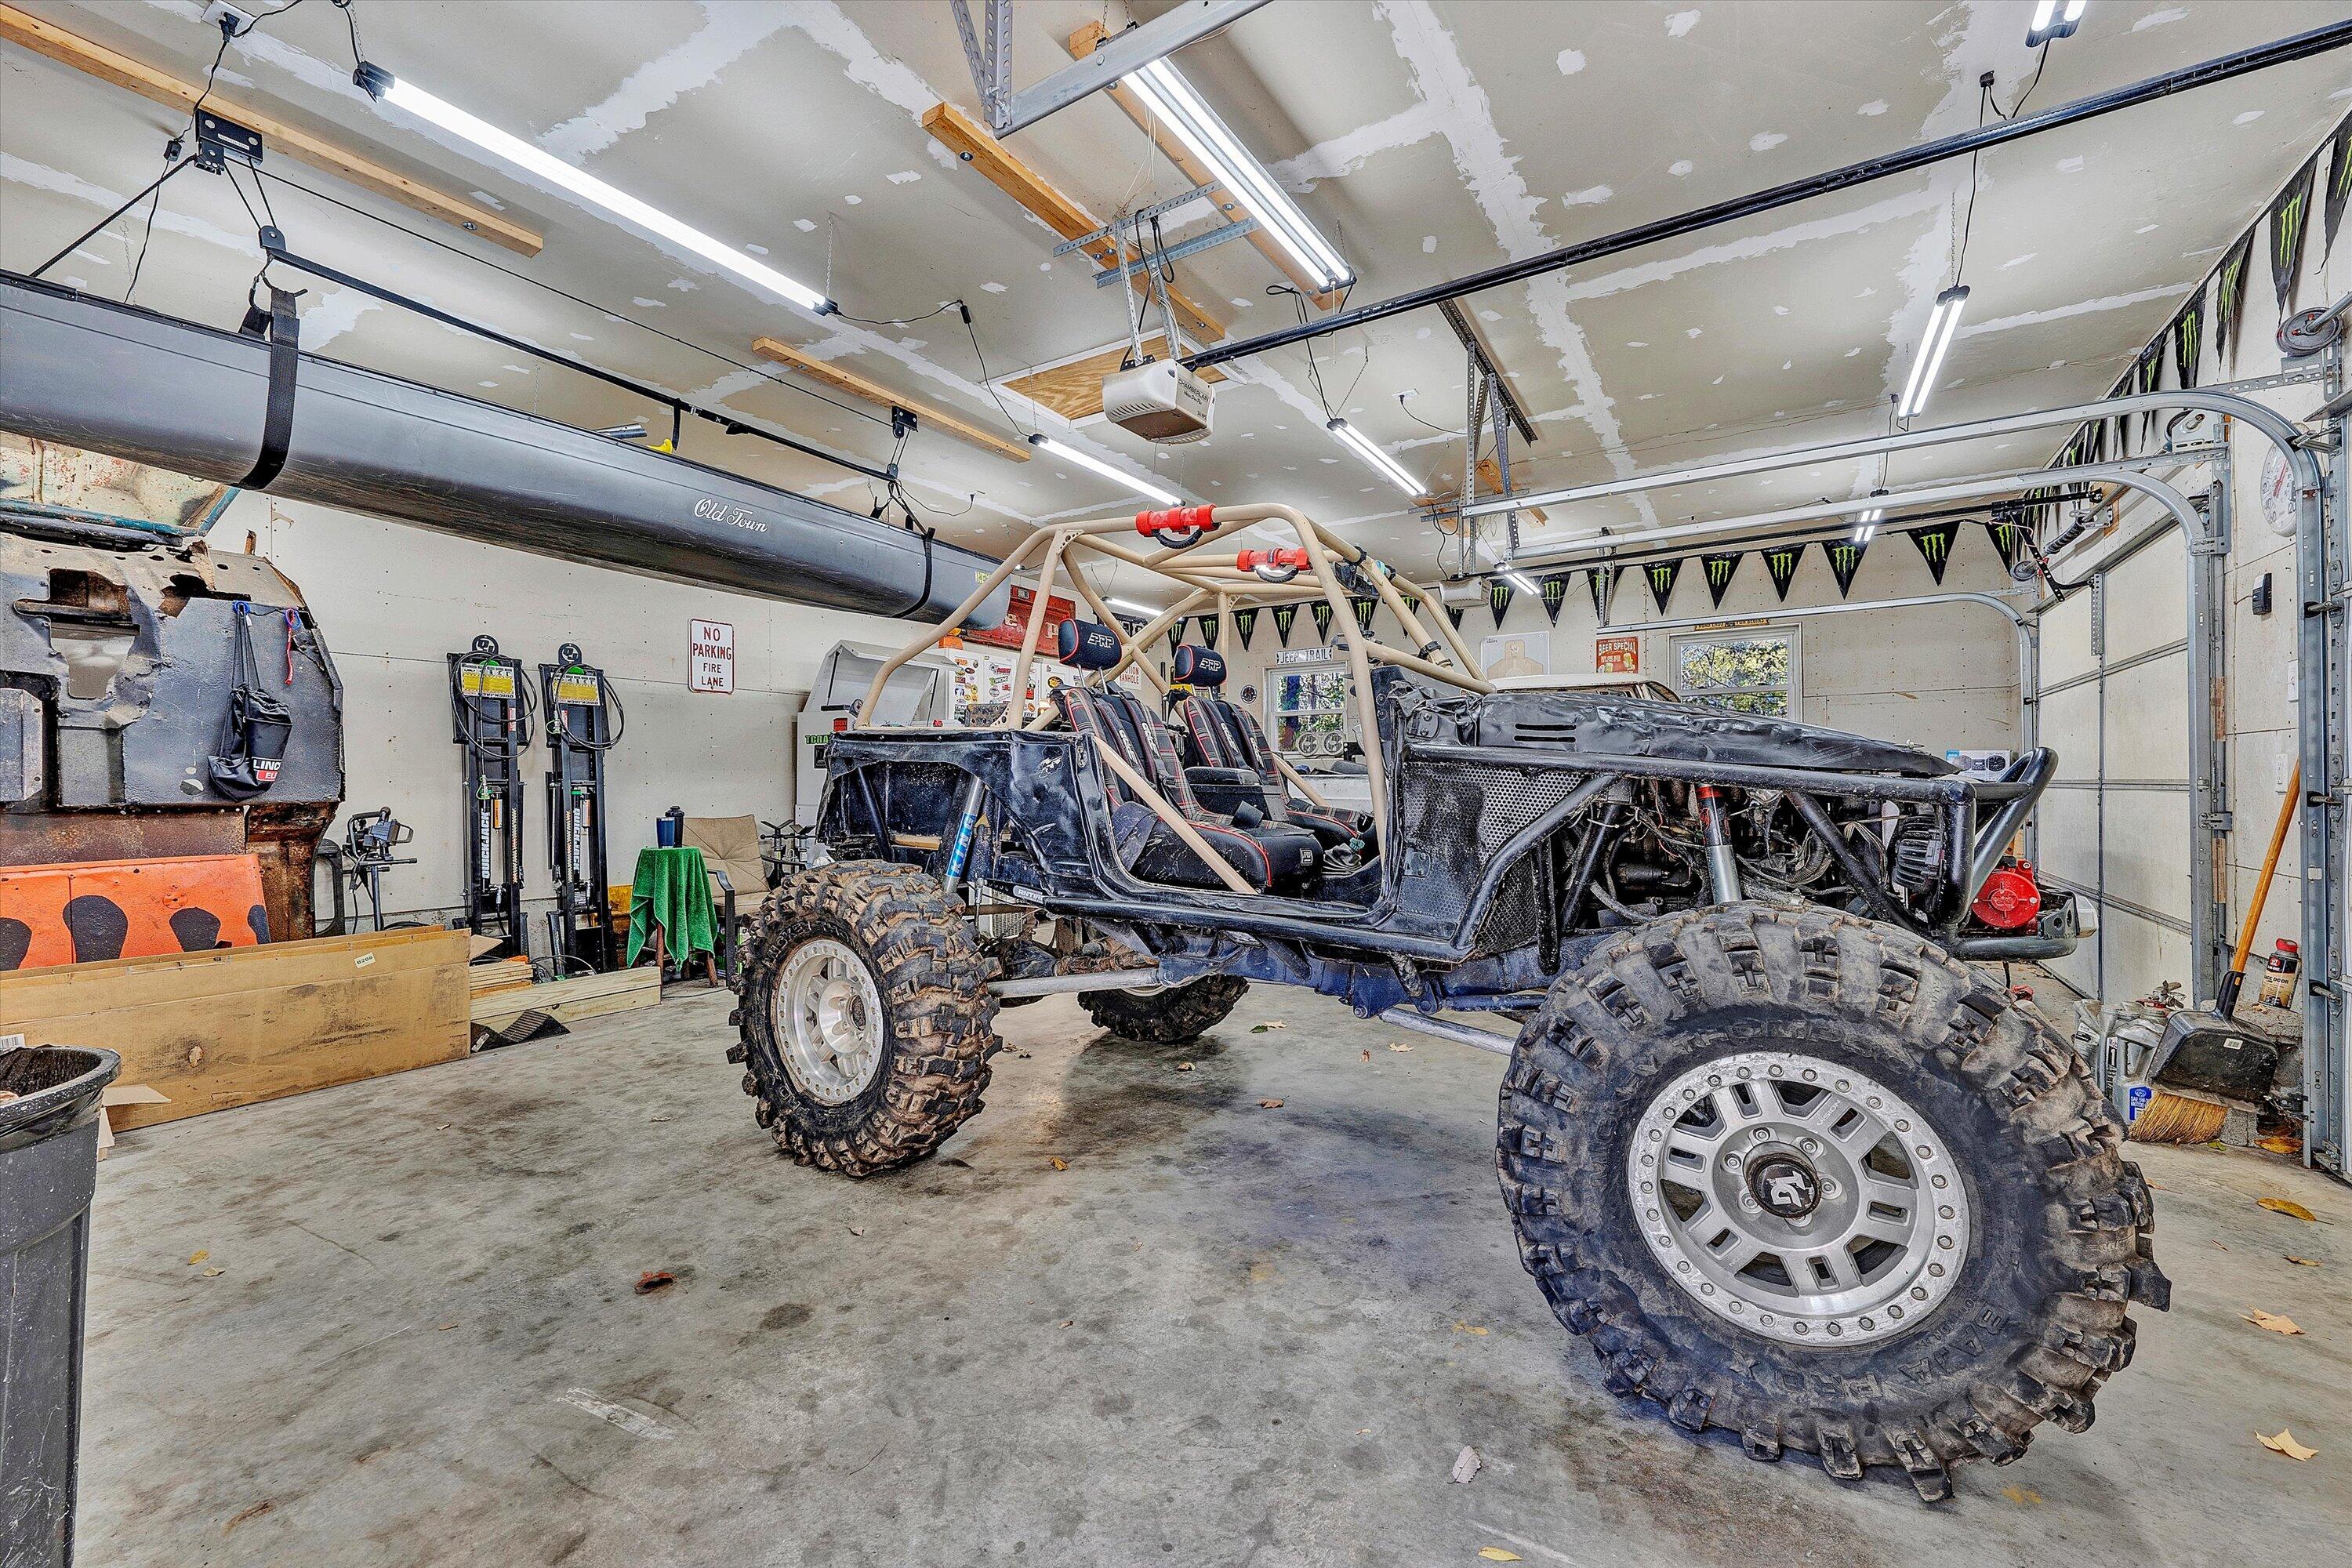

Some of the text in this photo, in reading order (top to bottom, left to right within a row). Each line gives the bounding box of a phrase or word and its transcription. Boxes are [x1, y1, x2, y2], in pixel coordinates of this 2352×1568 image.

[1178, 379, 1209, 403] CHAMBERLAIN
[694, 498, 768, 532] Old Town
[703, 626, 720, 641] NO
[1087, 632, 1115, 648] PRP
[692, 642, 731, 660] PARKING
[1279, 648, 1328, 664] JEEP TRAIL
[1598, 641, 1637, 656] BEER SPECIAL
[702, 662, 722, 673] FIRE
[1199, 657, 1221, 672] PRP
[701, 675, 724, 687] LANE
[805, 735, 829, 745] TCRA
[252, 759, 281, 771] LINC
[481, 811, 492, 880] QUICKJACK
[951, 814, 976, 874] KING
[1018, 888, 1044, 902] ANTIR
